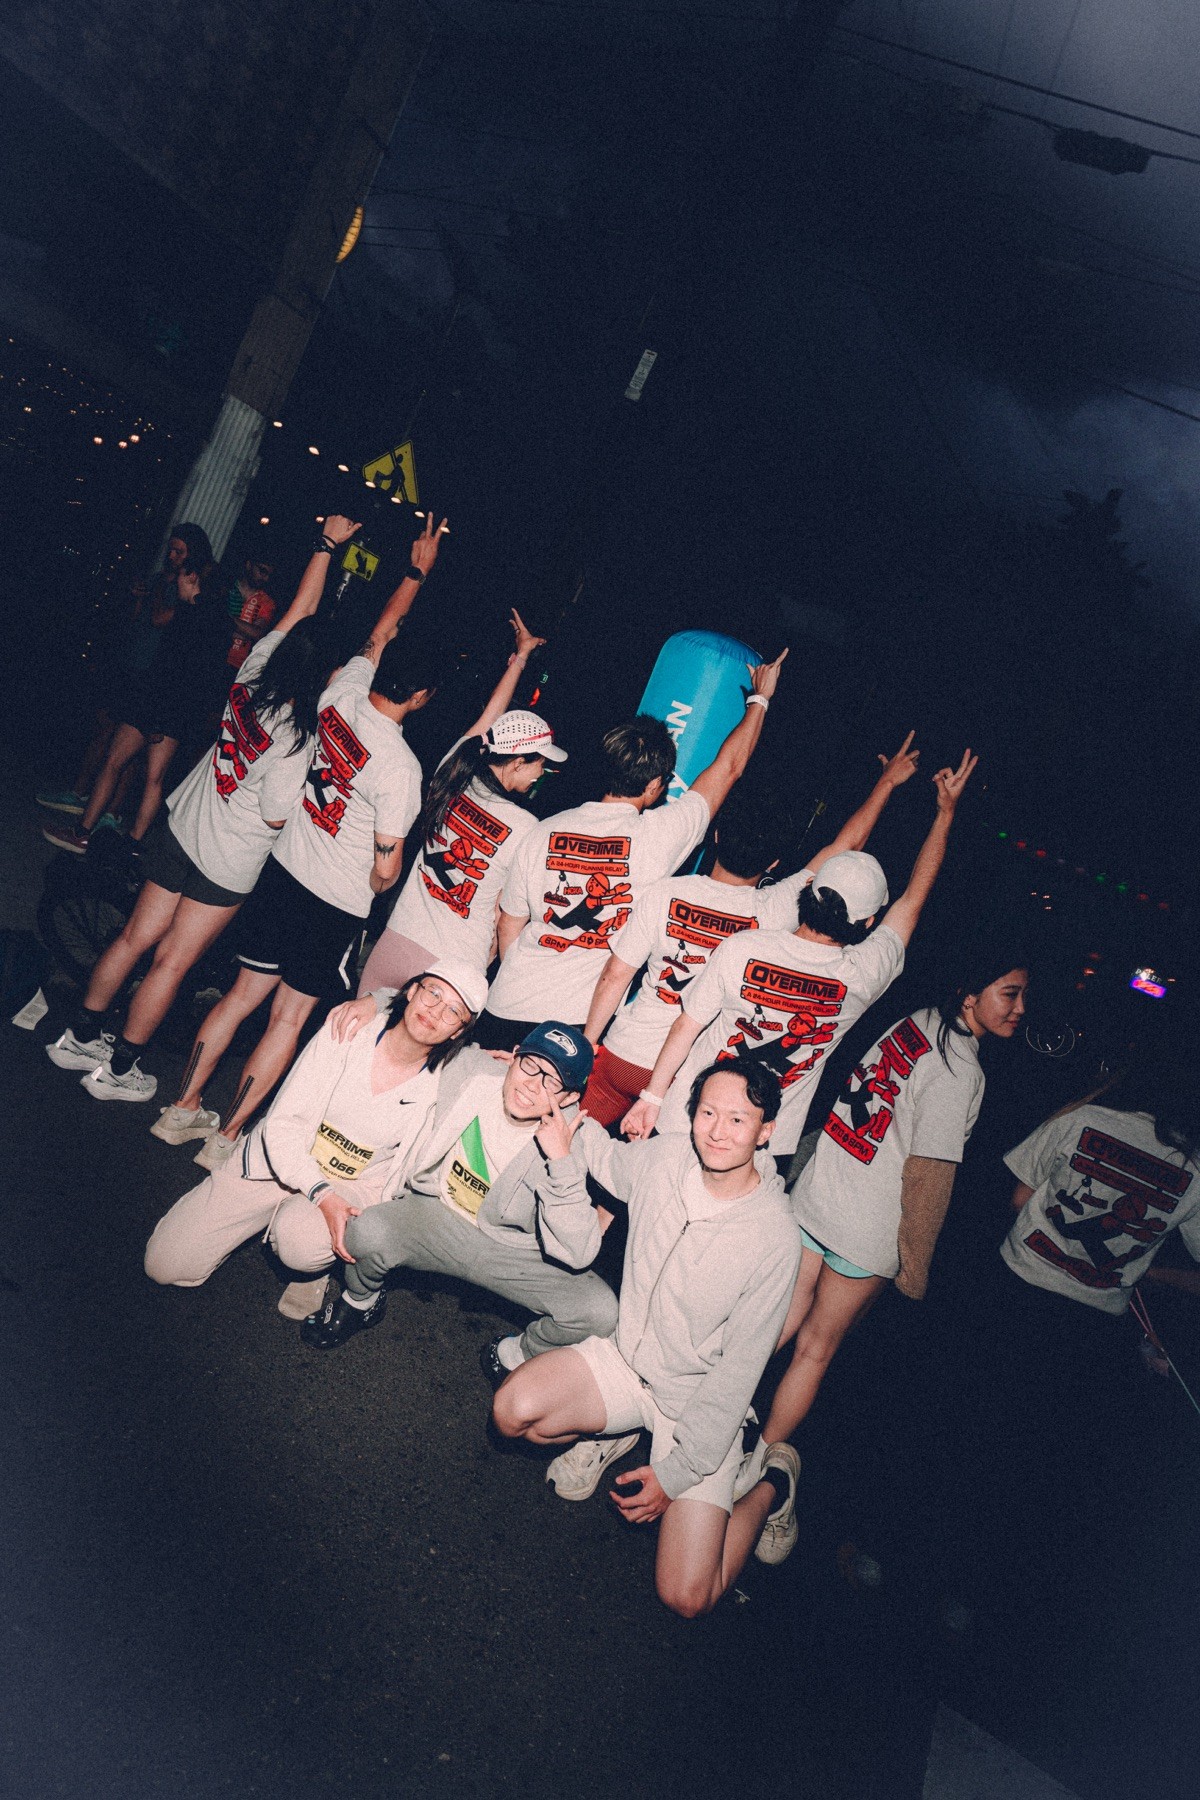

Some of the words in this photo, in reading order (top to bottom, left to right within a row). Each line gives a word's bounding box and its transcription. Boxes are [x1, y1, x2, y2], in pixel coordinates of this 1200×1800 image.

[554, 836, 624, 855] OVERTIME
[556, 861, 580, 870] 24-HOUR
[604, 865, 623, 873] RELAY
[682, 955, 706, 964] HOKA
[751, 965, 839, 998] OVERTIME
[752, 993, 781, 1005] 24-HOUR
[782, 1001, 812, 1011] RUNNING
[758, 1020, 783, 1032] HOKA
[318, 1122, 374, 1160] VERTIME
[329, 1156, 357, 1175] 066
